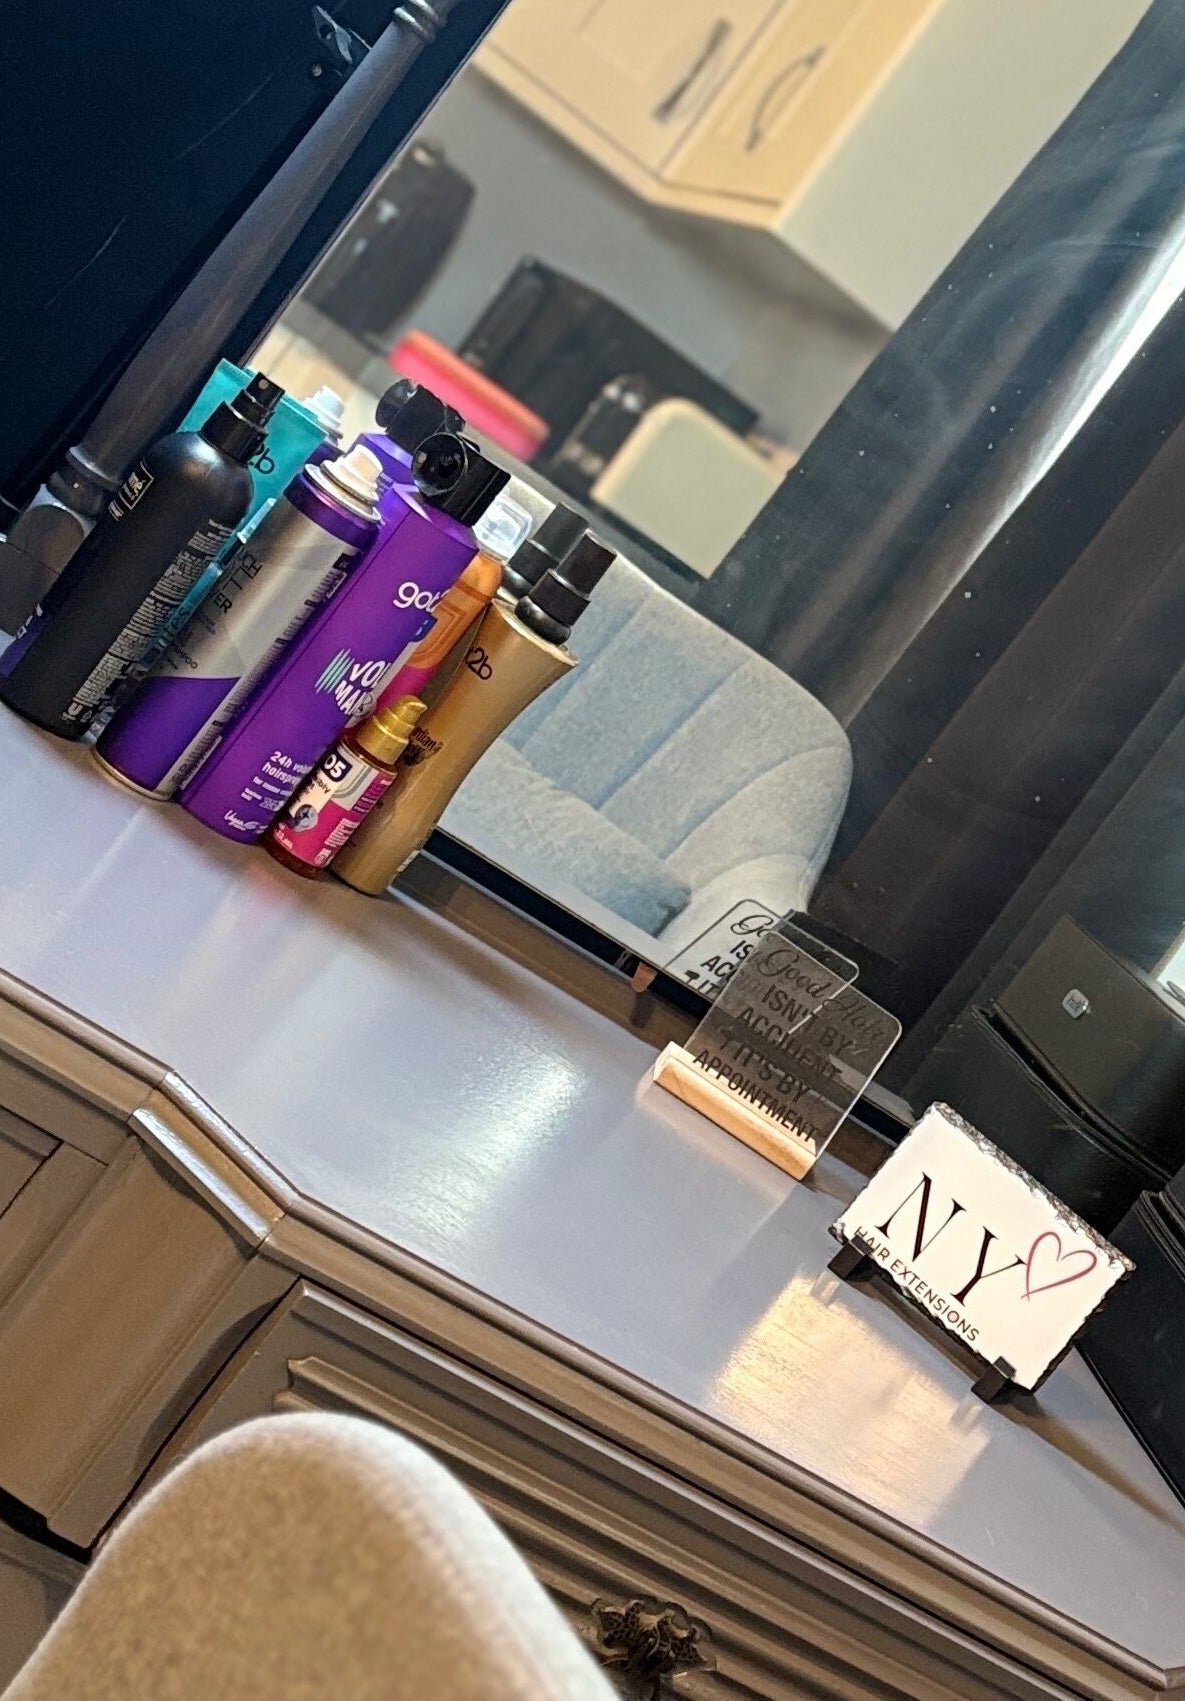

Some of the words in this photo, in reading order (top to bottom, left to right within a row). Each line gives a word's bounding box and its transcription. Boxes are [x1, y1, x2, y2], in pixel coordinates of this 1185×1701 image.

[393, 582, 450, 612] got
[324, 754, 347, 778] 05
[757, 950, 832, 998] Good
[821, 996, 884, 1041] Hair
[761, 984, 819, 1033] ISN'T
[819, 1026, 854, 1056] BY
[733, 1041, 774, 1081] IT'S
[776, 1072, 811, 1103] BY
[736, 1007, 842, 1083] ACCIDENT
[693, 1049, 820, 1143] APPOINTMENT
[854, 1226, 890, 1262] HAIR
[890, 1259, 980, 1341] EXTENSIONS
